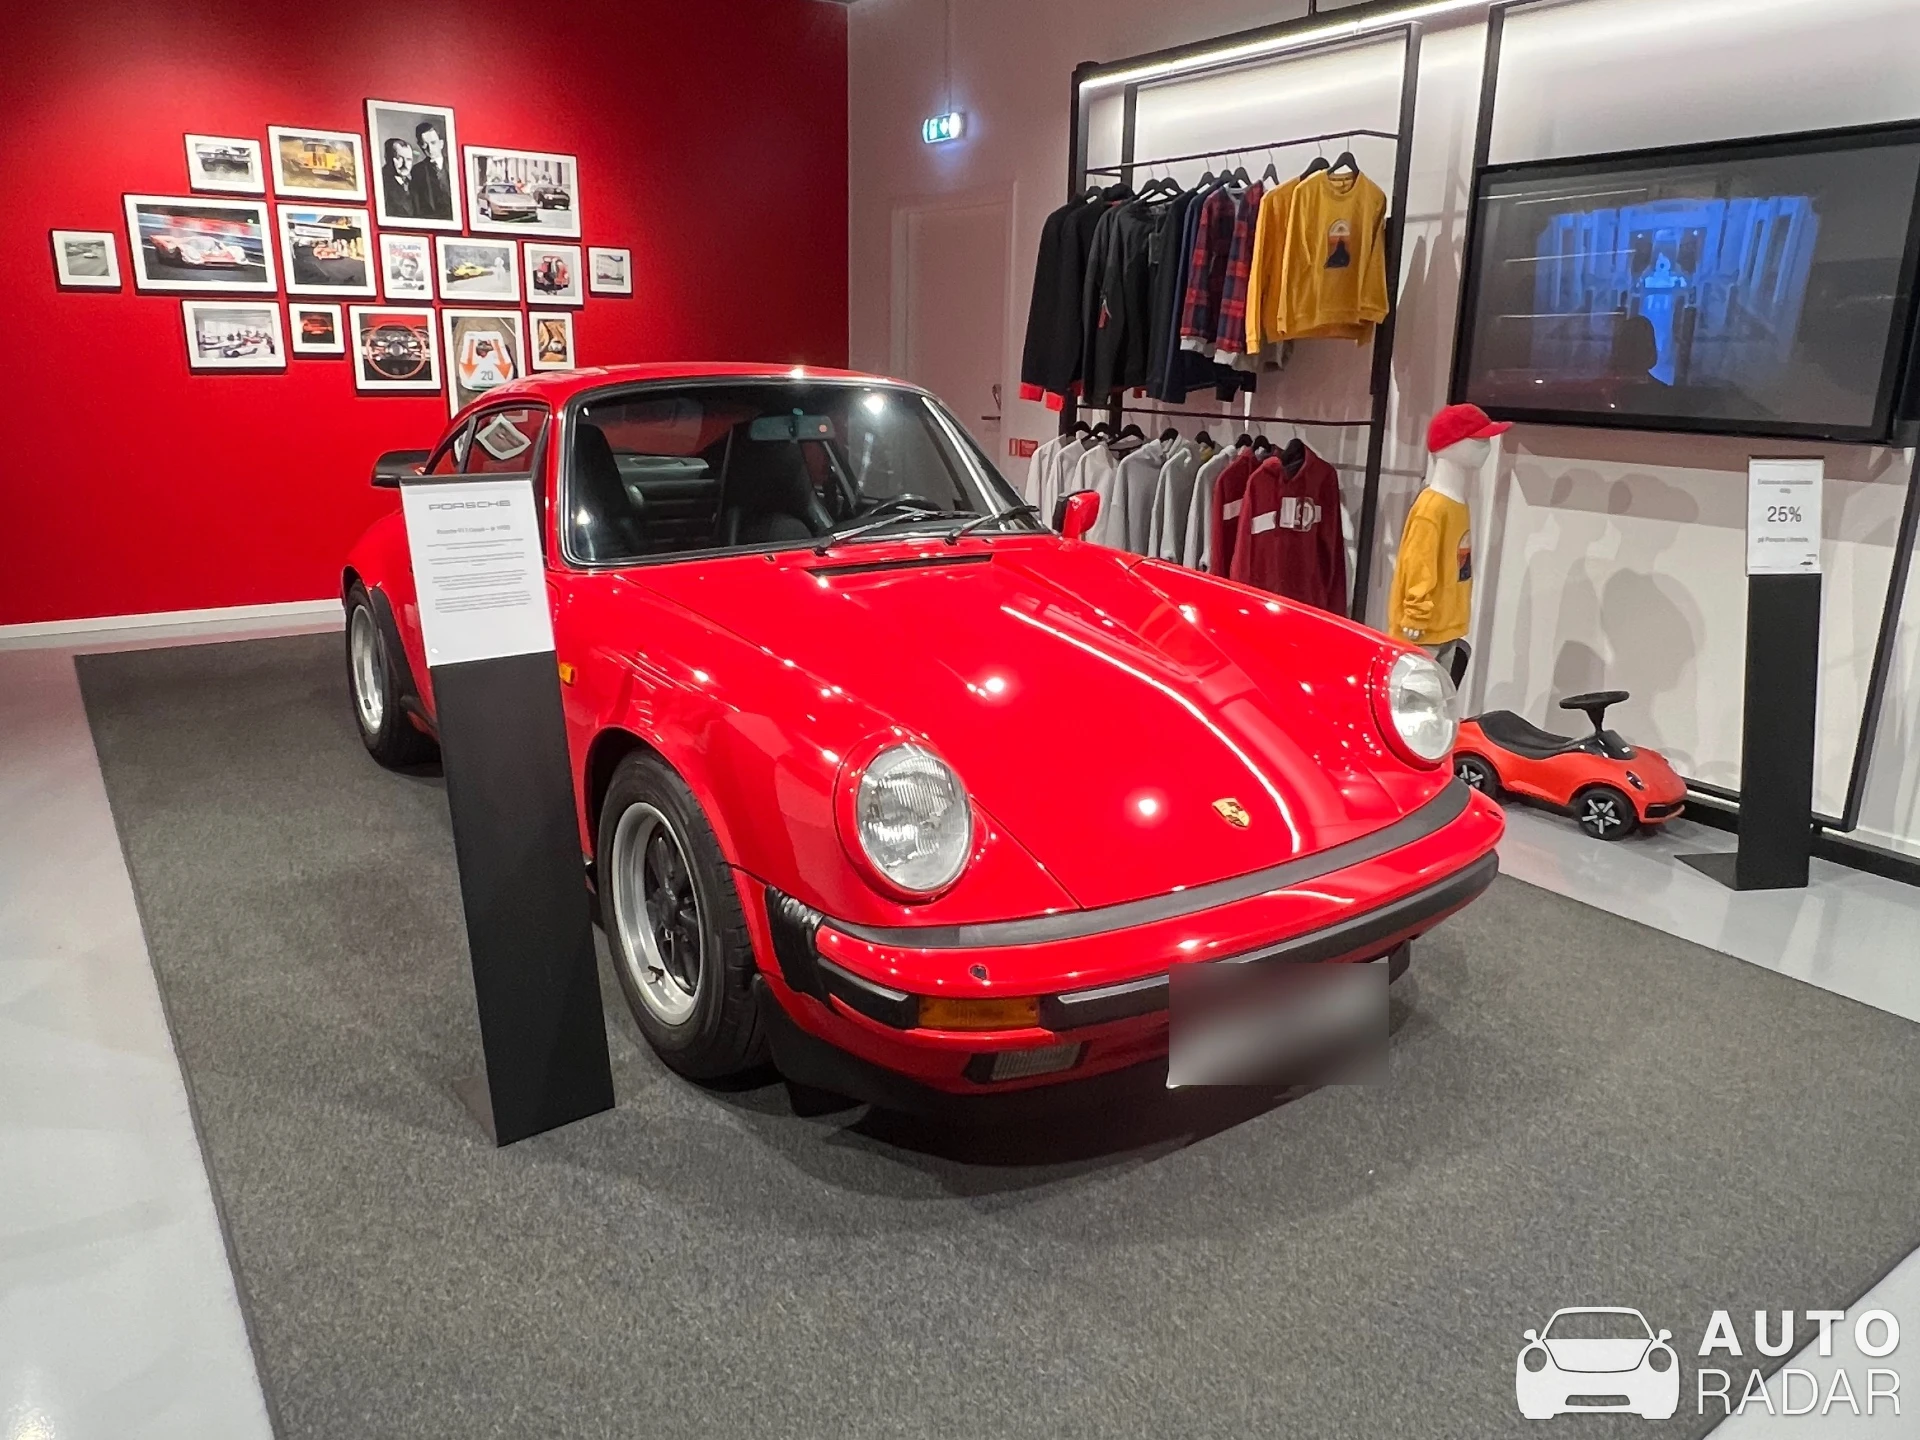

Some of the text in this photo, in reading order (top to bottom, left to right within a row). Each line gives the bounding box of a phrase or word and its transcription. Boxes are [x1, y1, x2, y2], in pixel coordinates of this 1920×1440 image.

[481, 370, 494, 381] 20
[428, 500, 511, 510] PORSCHE
[1767, 506, 1802, 522] 25%
